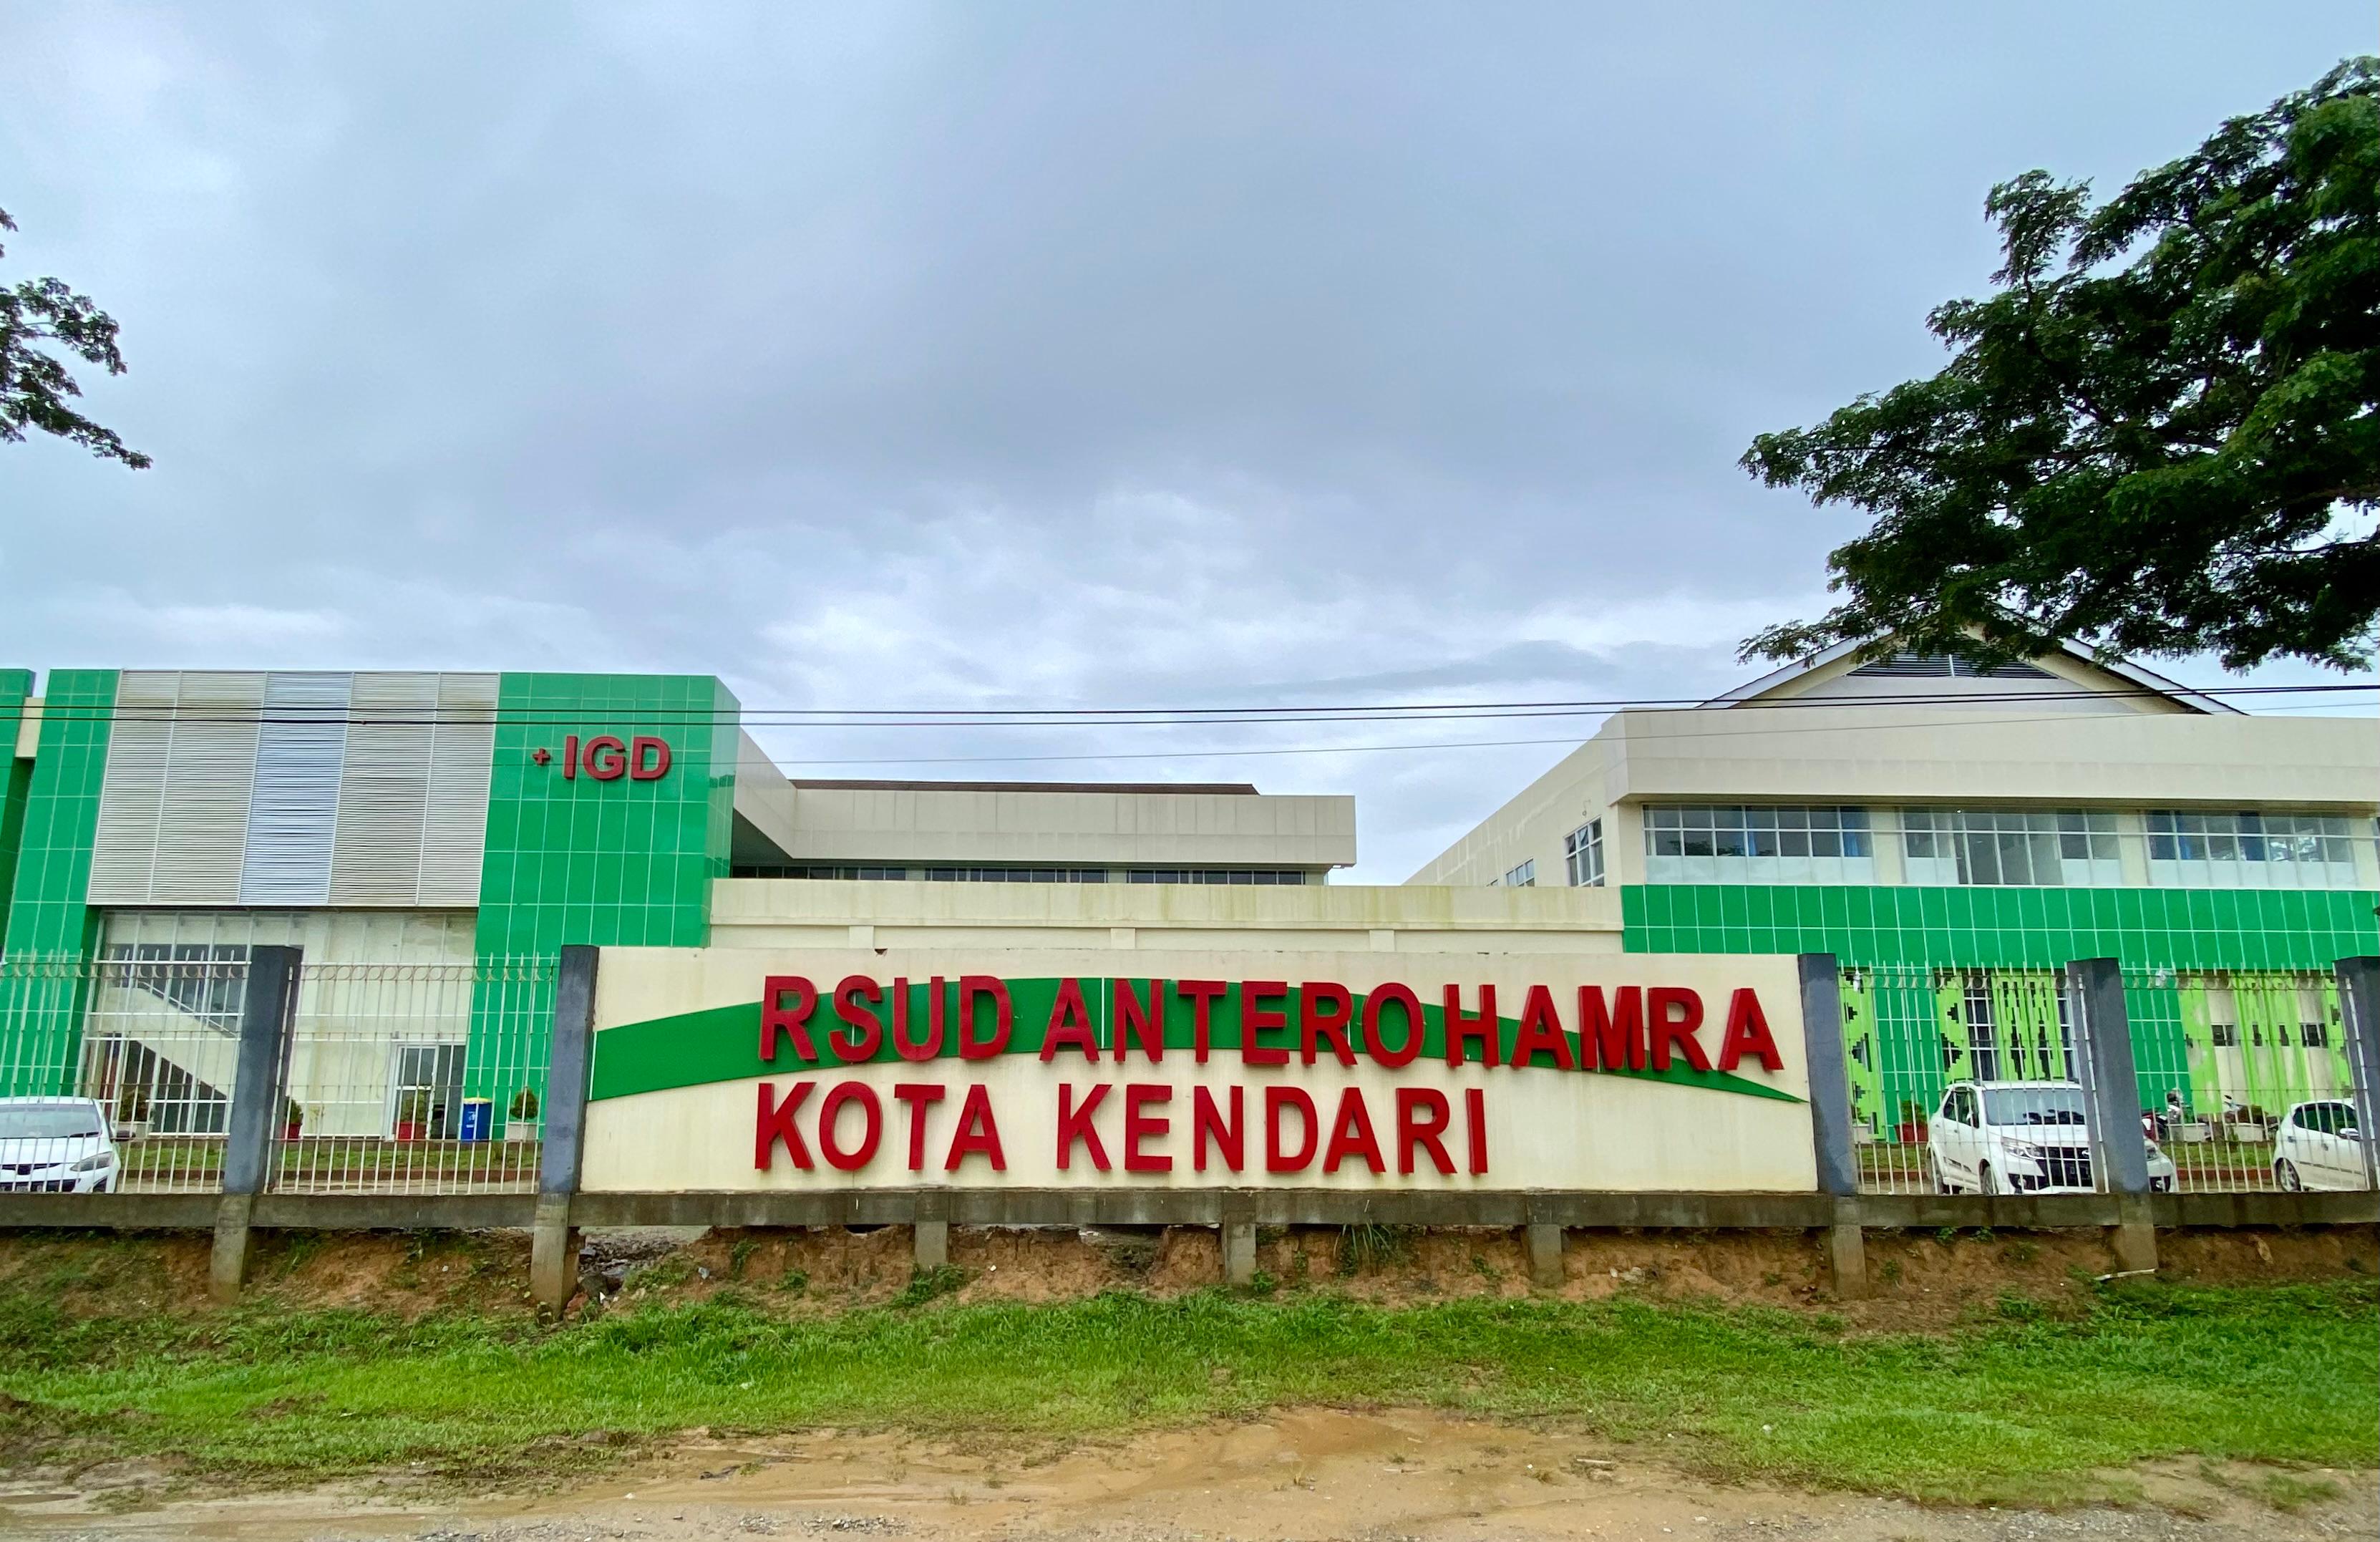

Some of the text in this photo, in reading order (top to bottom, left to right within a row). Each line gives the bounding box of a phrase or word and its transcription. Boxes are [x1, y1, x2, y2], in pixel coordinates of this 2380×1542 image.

[563, 736, 671, 780] IGD
[759, 974, 1784, 1071] RSUD ANTERO HAMRA
[754, 1081, 1489, 1175] KOTA KENDARI
